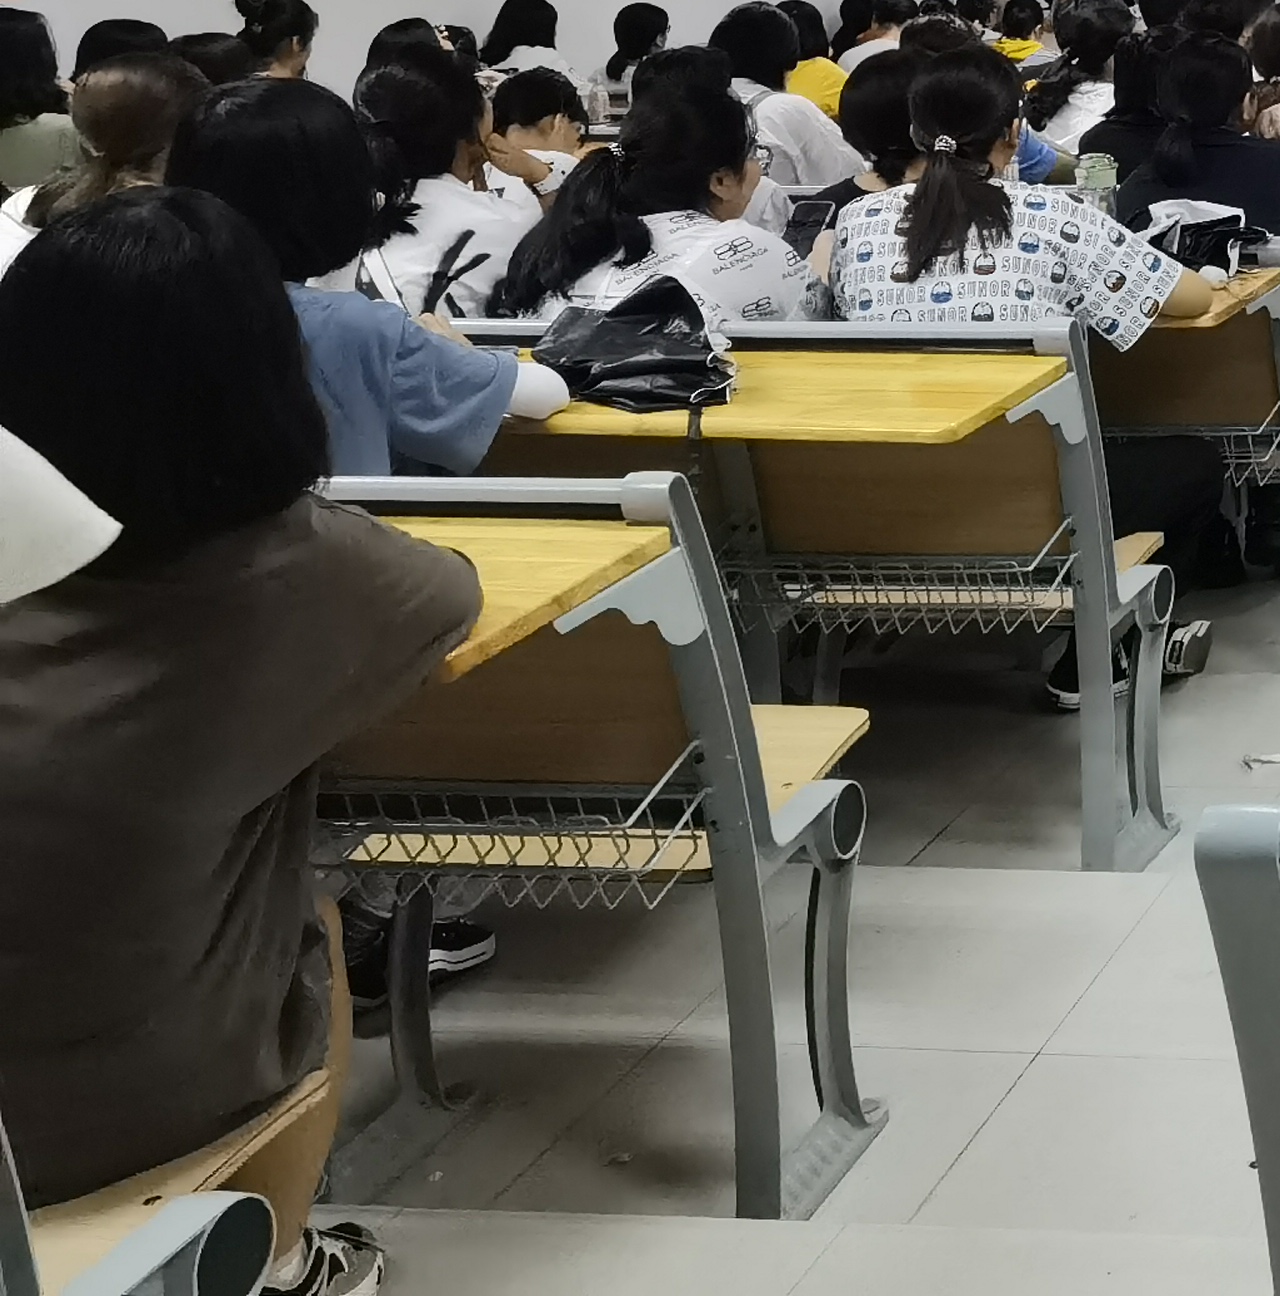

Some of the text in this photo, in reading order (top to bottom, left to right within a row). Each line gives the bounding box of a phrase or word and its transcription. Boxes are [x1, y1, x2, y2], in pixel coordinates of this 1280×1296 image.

[1014, 212, 1058, 235] UNOR
[1001, 255, 1049, 279] SUNOR
[876, 286, 926, 306] SUNOR
[957, 279, 1011, 299] SUNOR
[1113, 270, 1151, 317] SUNOR
